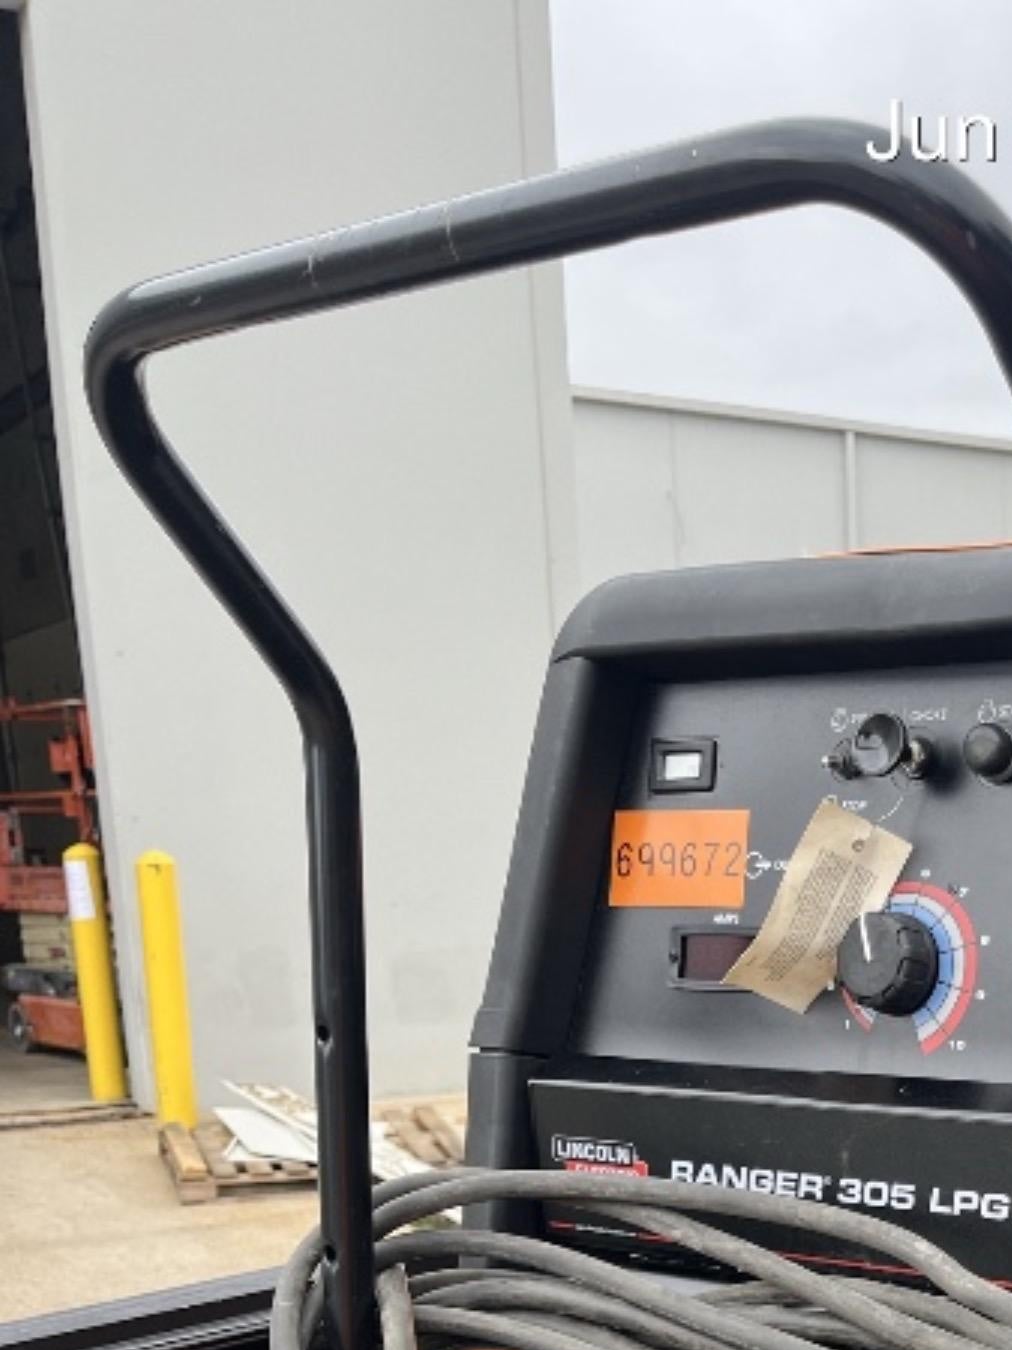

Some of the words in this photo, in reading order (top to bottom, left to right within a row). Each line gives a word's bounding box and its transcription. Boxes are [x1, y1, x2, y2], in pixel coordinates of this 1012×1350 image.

[616, 841, 743, 878] 699672
[556, 1138, 631, 1165] LINCOLN
[836, 1177, 916, 1211] 305
[929, 1187, 1011, 1222] LPG
